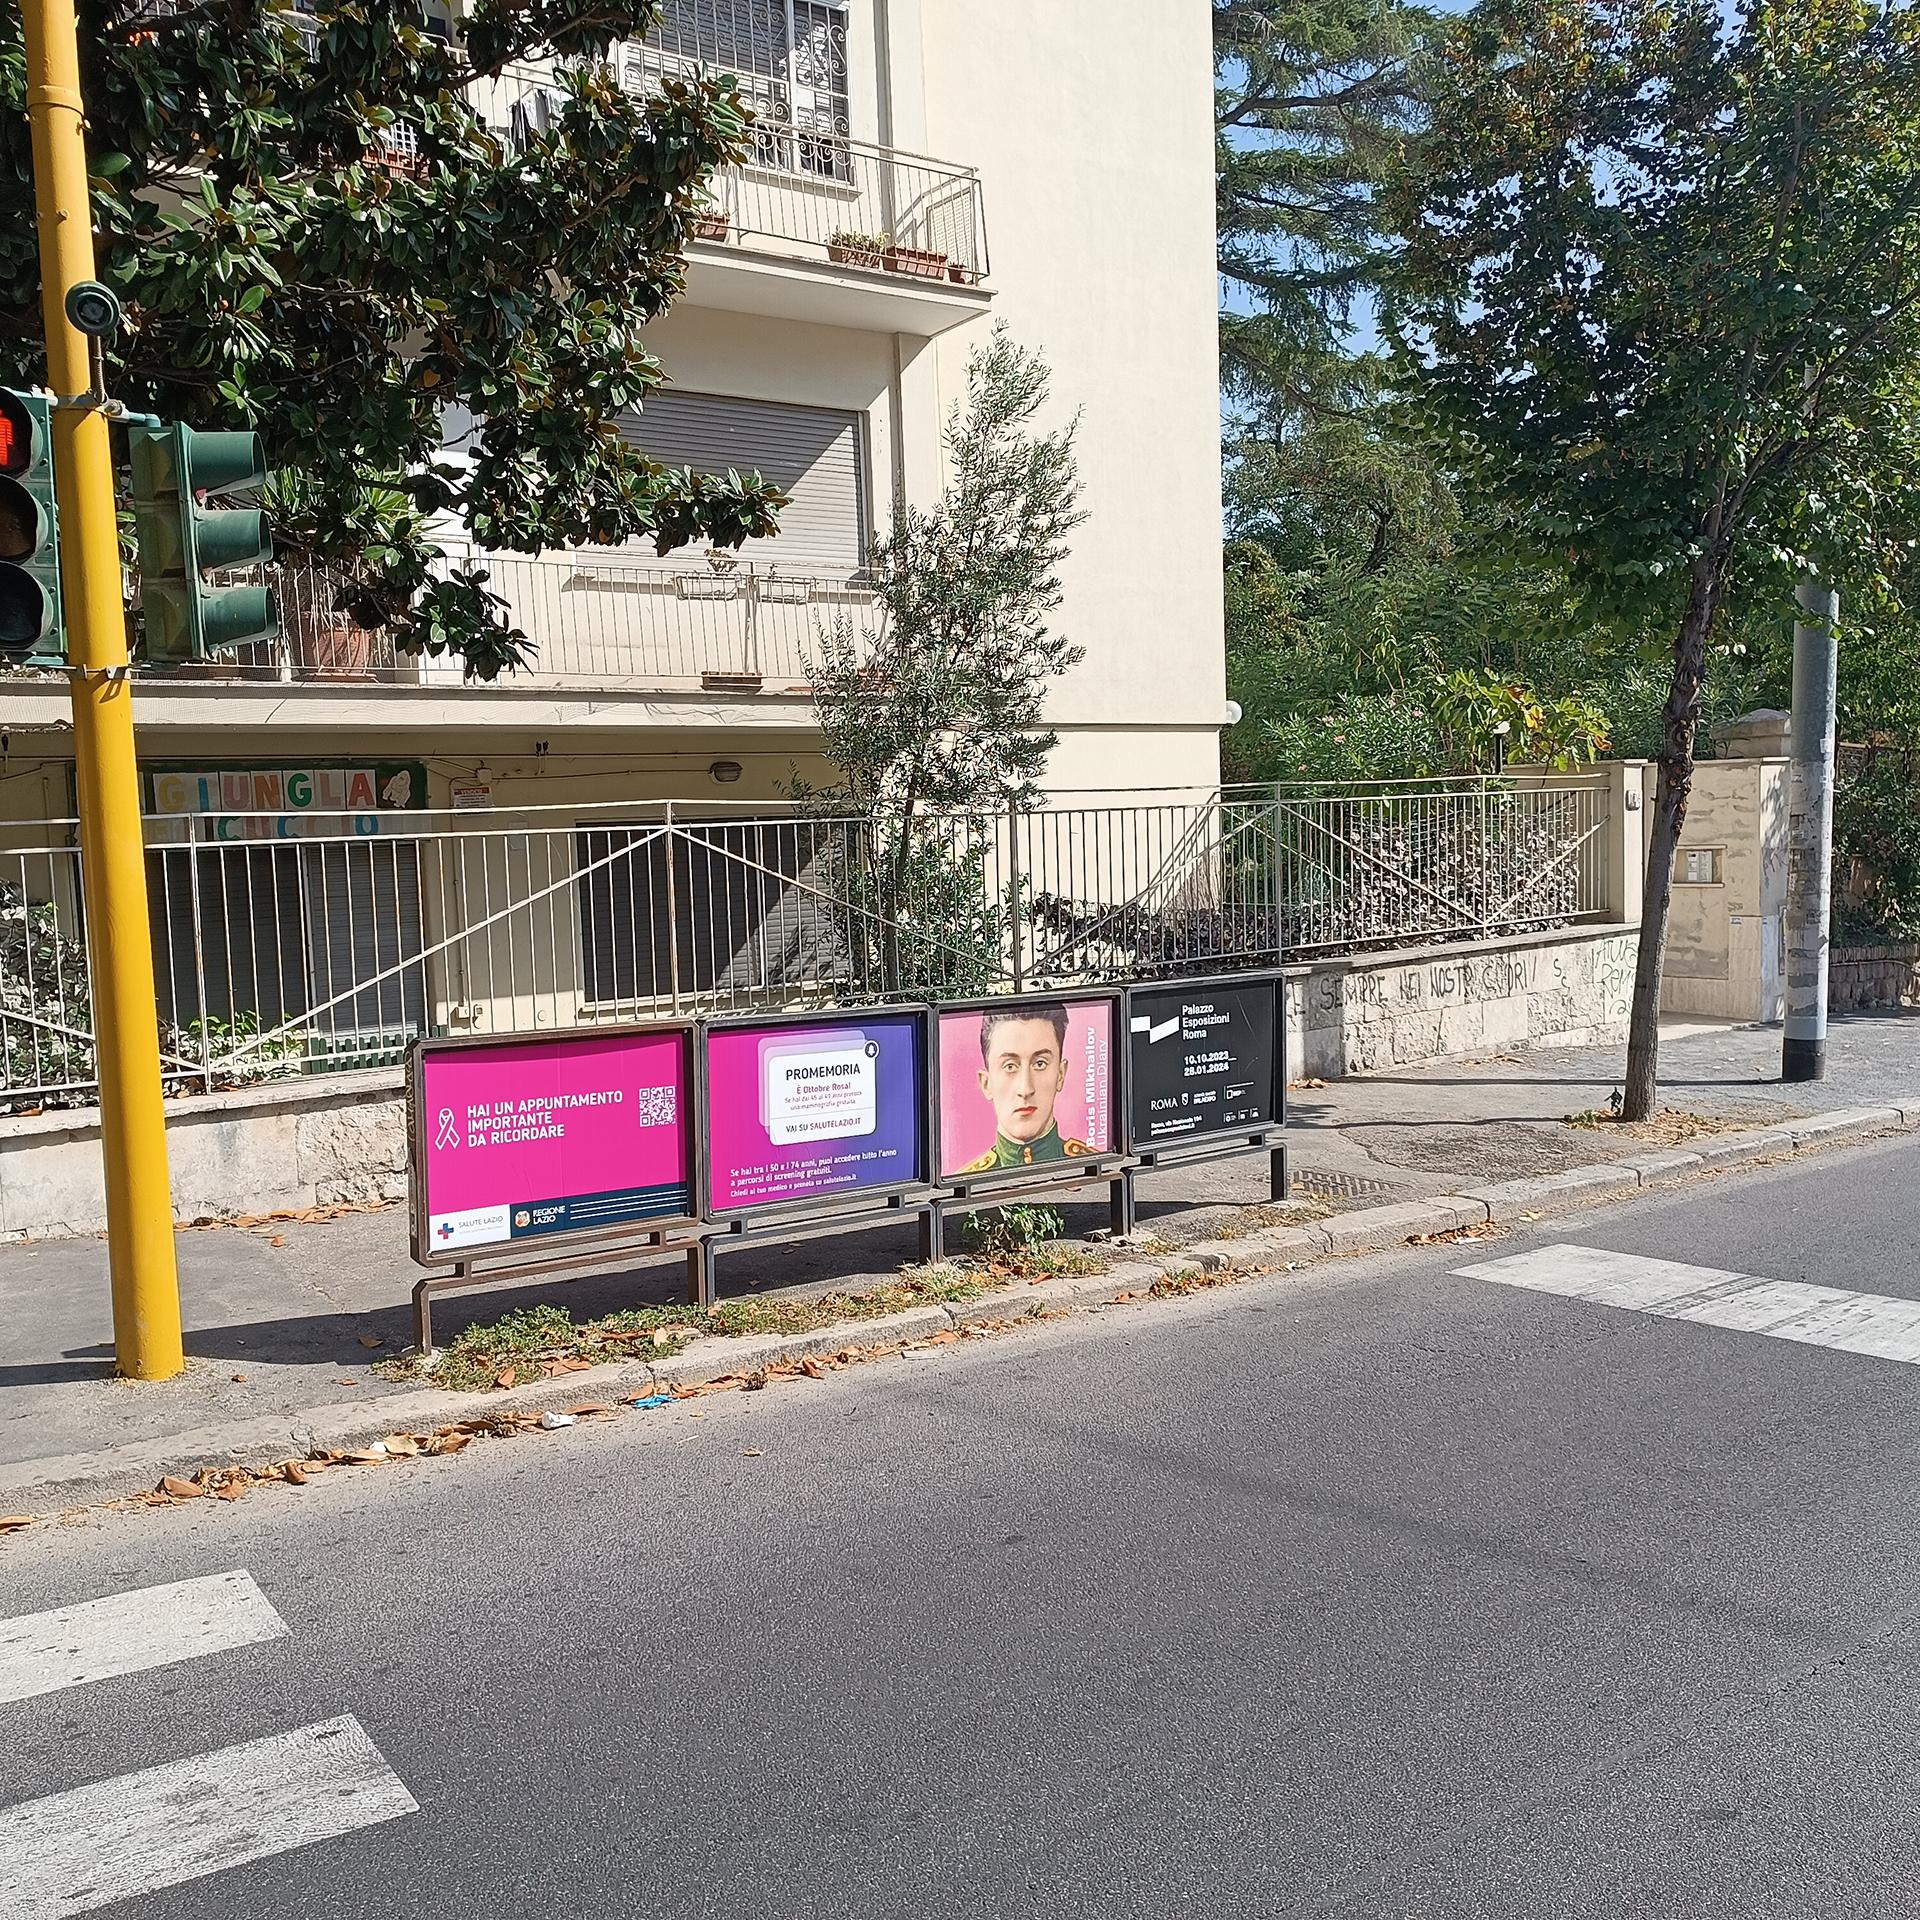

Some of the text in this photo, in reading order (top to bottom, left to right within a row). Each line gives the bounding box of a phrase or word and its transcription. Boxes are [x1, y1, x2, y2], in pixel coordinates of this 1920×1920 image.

[159, 773, 376, 812] GIUNGLA
[1320, 975, 1388, 1010] SEMPRE
[1182, 1004, 1214, 1016] Palazzo
[1182, 1012, 1230, 1029] Esposizioni
[1183, 1029, 1208, 1040] Roma
[786, 1063, 861, 1080] PROMEMORIA
[1184, 1062, 1229, 1077] 28.01.2024
[803, 1085, 830, 1094] Ottobre
[832, 1082, 851, 1091] Rosa!
[1085, 1026, 1097, 1148] Boris Mikhailov
[1097, 1039, 1108, 1146] Ukrainian Diary
[467, 1090, 623, 1118] HAI UN APPUNTAMENTO
[1151, 1098, 1178, 1110] ROMA
[468, 1111, 552, 1133] IMPORTANTE
[786, 1118, 862, 1133] VAI SU SALUTELAZIO.IT
[468, 1124, 565, 1147] DA RICORDARE
[730, 1168, 739, 1177] Se
[740, 1167, 752, 1176] hai
[753, 1166, 764, 1174] tra
[770, 1163, 778, 1172] 50
[790, 1161, 800, 1170] 74
[818, 1156, 833, 1166] puoi
[834, 1152, 860, 1164] accedere
[862, 1151, 877, 1161] tutto
[737, 1175, 764, 1187] percorsi
[765, 1174, 773, 1182] di
[773, 1169, 806, 1181] screening
[532, 1205, 565, 1217] REGIONE
[533, 1214, 556, 1225] LAZIO
[458, 1215, 504, 1228] SALUTE LAZIO
